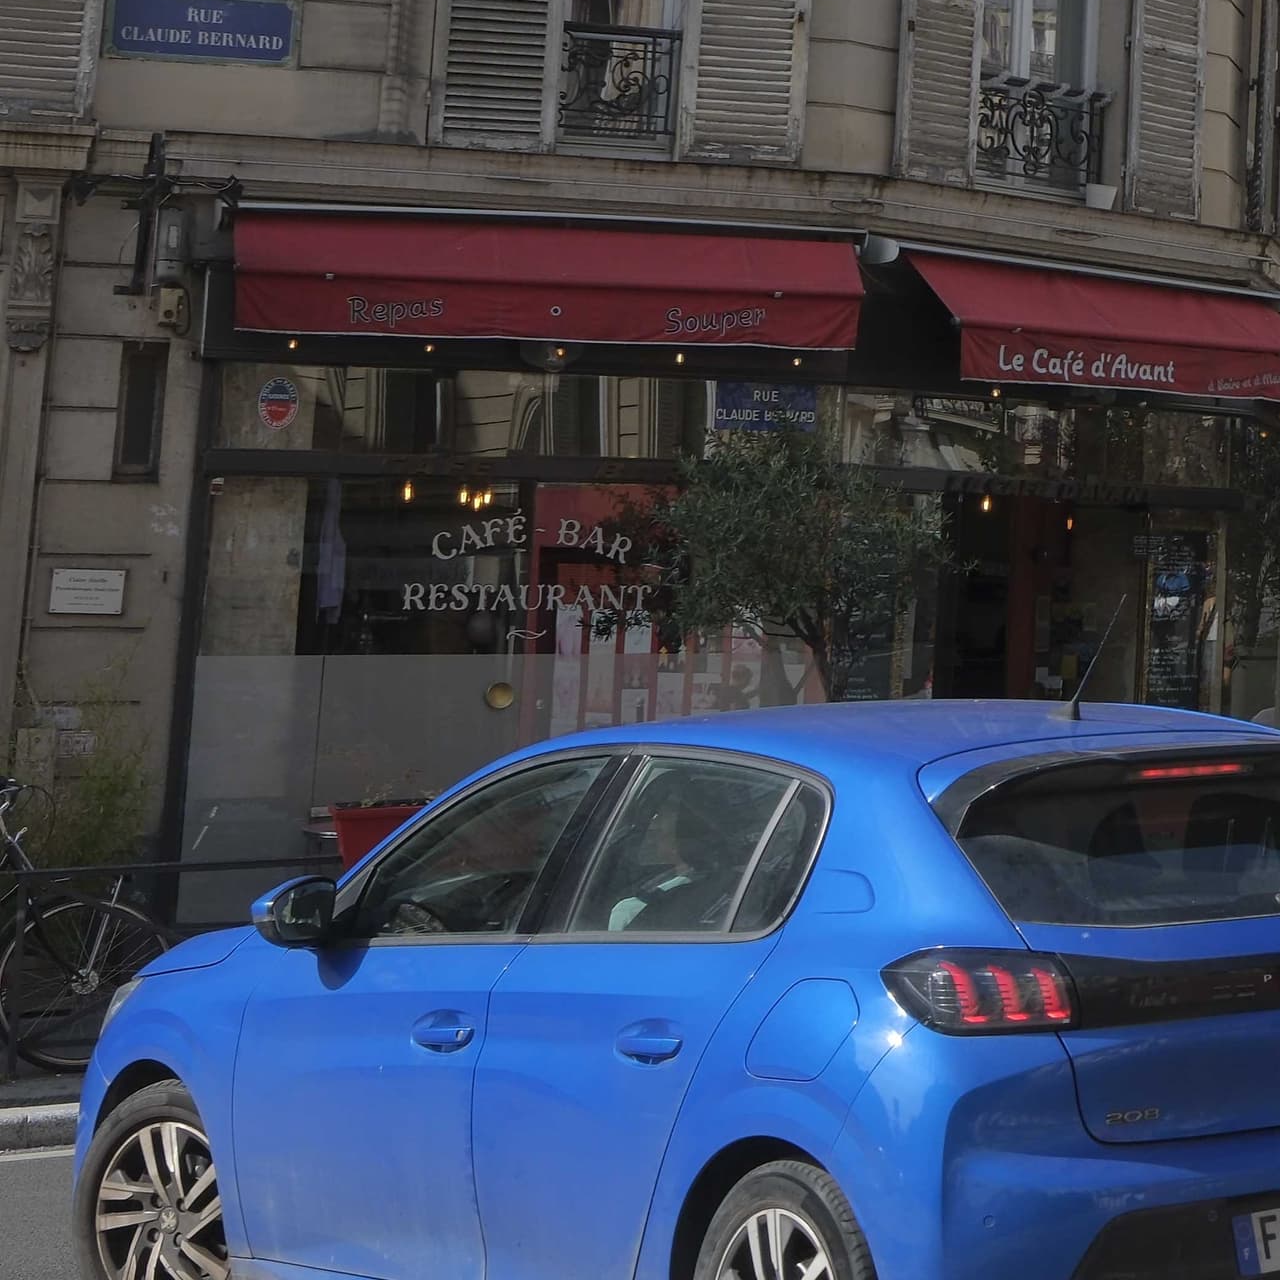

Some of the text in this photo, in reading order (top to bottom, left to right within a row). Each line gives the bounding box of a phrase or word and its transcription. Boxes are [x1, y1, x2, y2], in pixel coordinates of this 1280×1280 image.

[186, 7, 224, 24] RUE
[121, 26, 283, 50] CLAUDE BERNARD
[347, 296, 443, 327] Repas
[664, 305, 766, 337] Souper
[999, 344, 1176, 384] Le Café d'Avant
[753, 390, 780, 402] RUE
[716, 408, 760, 422] CLAUDE
[432, 508, 527, 560] CAFÉ
[556, 518, 633, 564] BAR
[402, 582, 651, 612] RESTAURANT
[1104, 1108, 1160, 1125] 208
